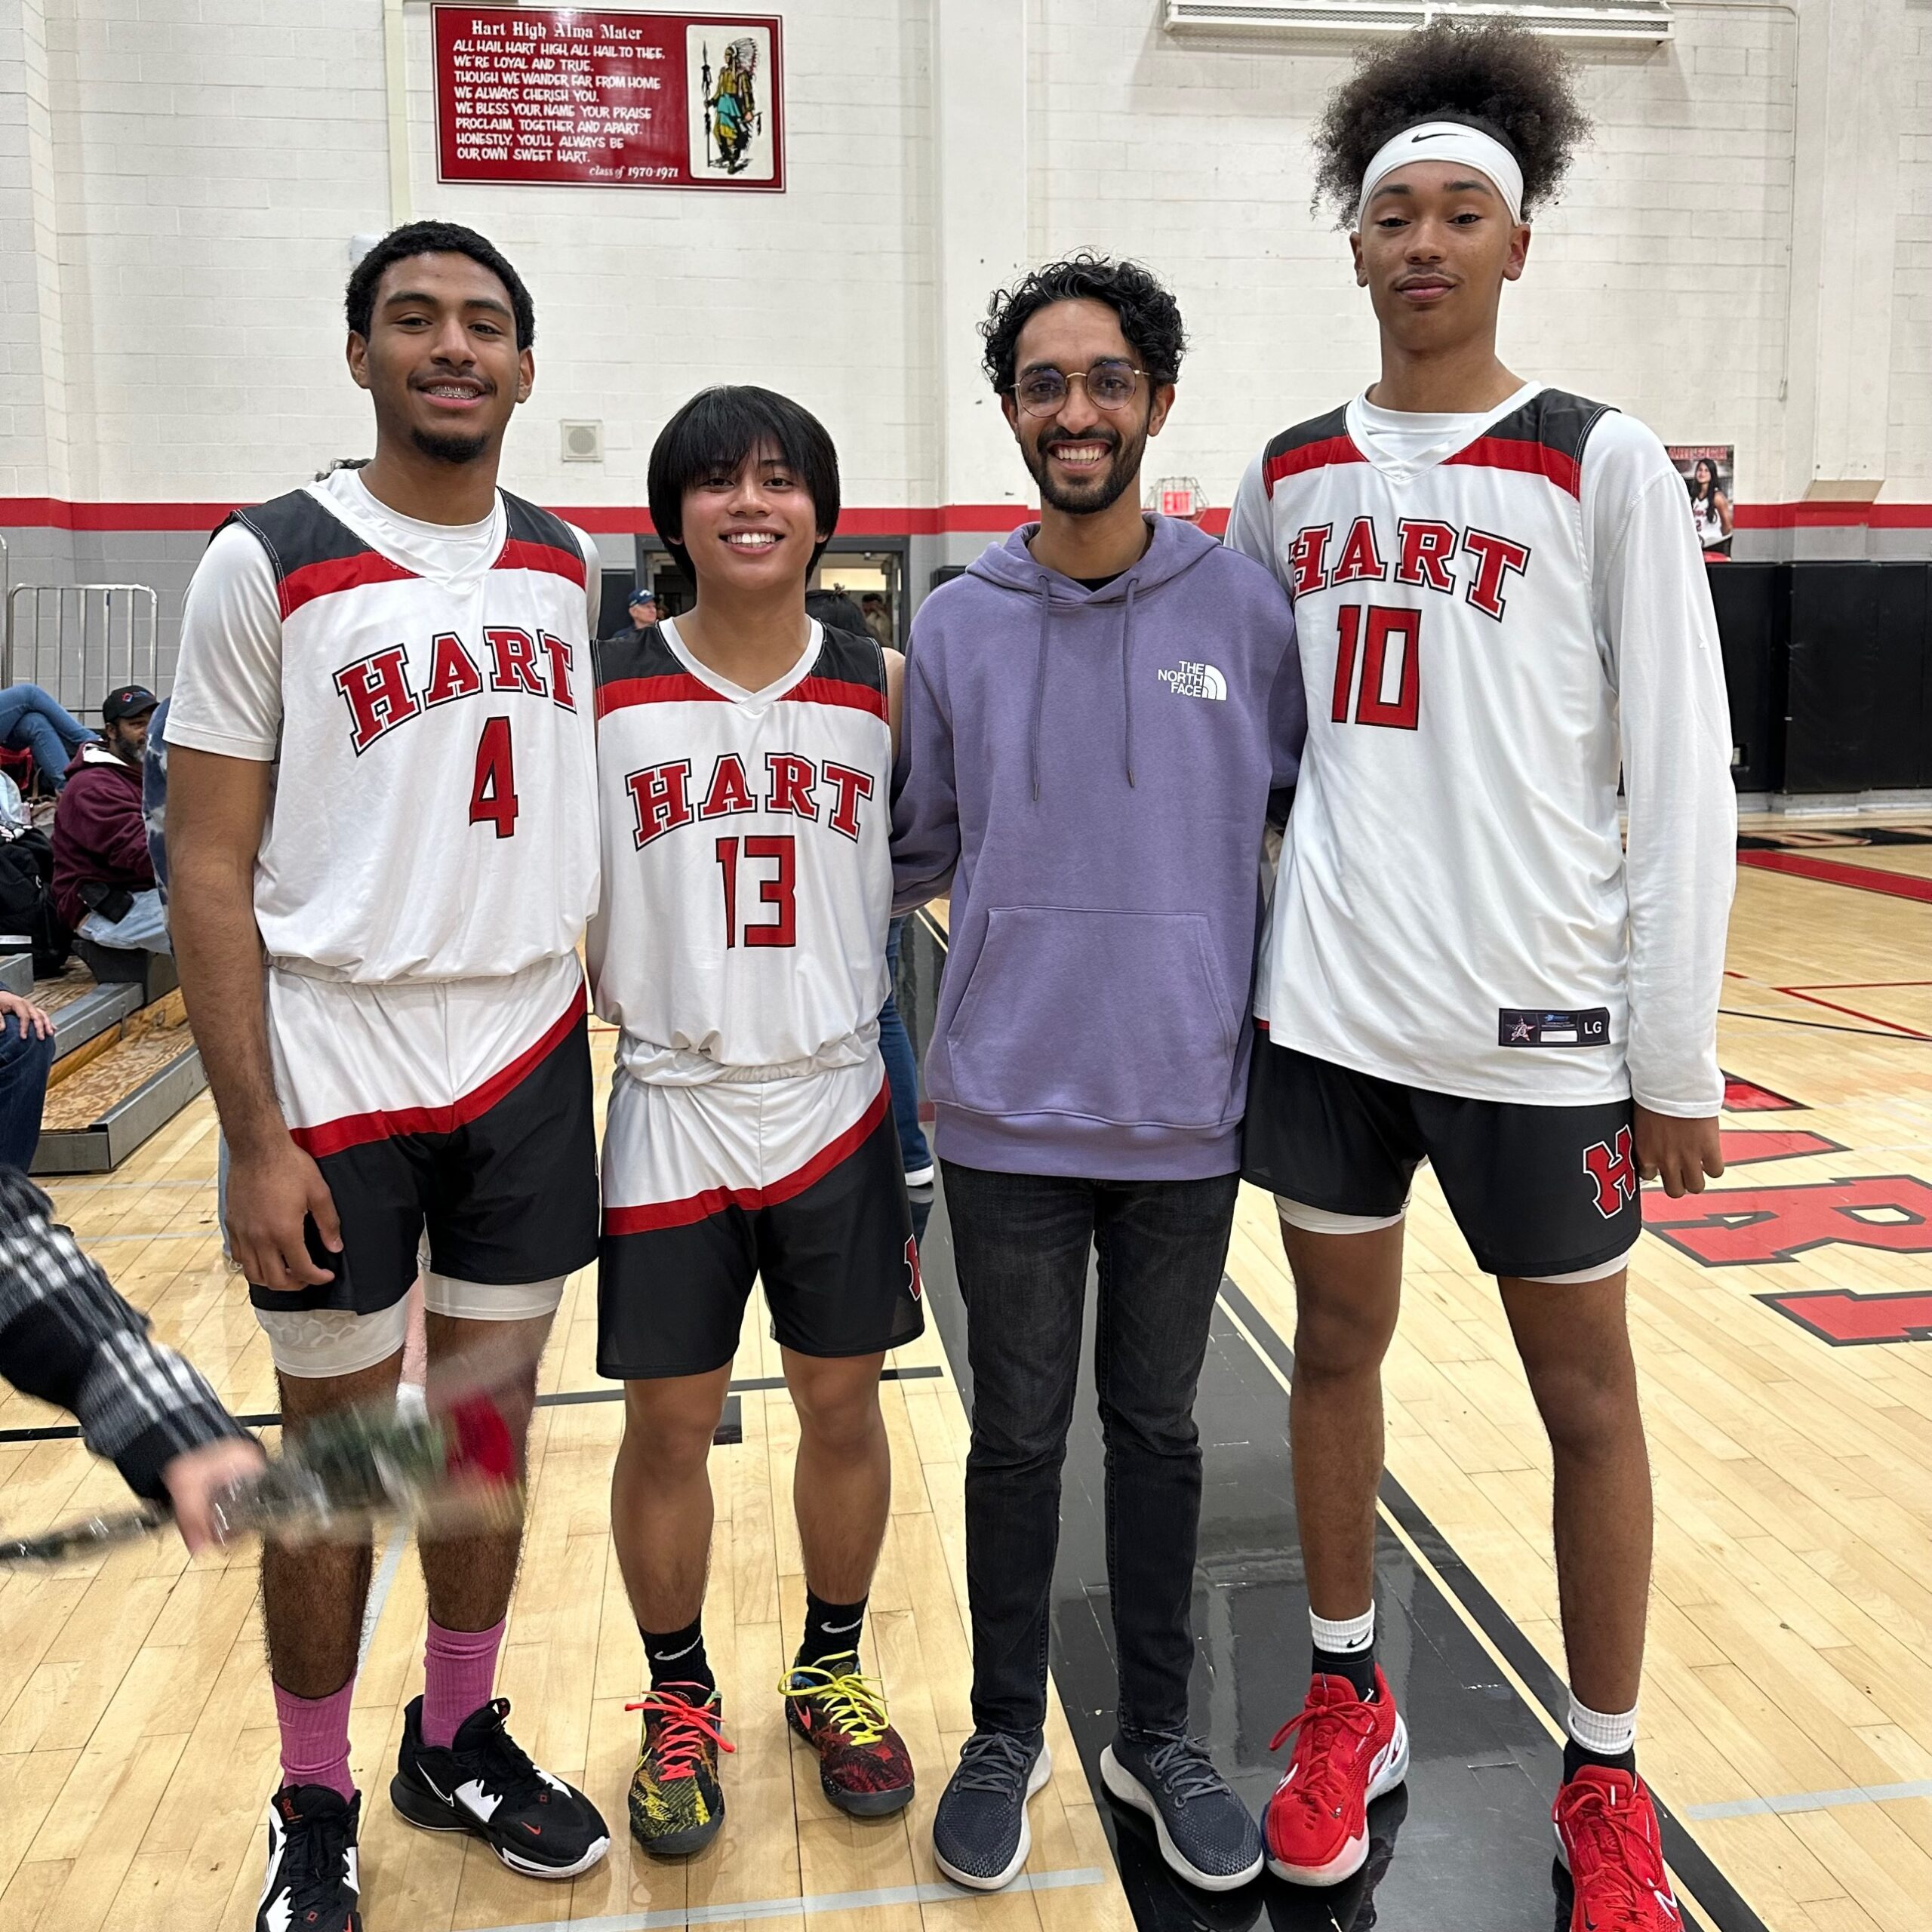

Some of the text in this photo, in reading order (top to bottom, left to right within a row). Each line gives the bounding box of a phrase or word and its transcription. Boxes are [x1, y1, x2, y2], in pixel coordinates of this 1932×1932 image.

[472, 20, 642, 40] Hart High Alma Mater
[454, 39, 474, 52] ALL
[476, 40, 503, 53] HAIL
[505, 42, 536, 55] HART
[571, 44, 591, 57] ALL
[593, 45, 618, 57] HAIL
[619, 46, 633, 58] TO
[635, 47, 665, 60] THEE.
[454, 54, 594, 72] WE'RE LOYAL AND TRUE.
[454, 70, 661, 90] THOUGH WE WANDER FAR FROM HOME
[454, 85, 599, 103] WE ALWAYS CHERISH YOU.
[455, 101, 652, 120] WE BLESS YOUR NAME YOUR PRAISE
[455, 117, 643, 136] PROCLAIM, TOGETHER AND APART.
[456, 132, 624, 149] HONESTLY, YOU'LL ALWAYS BE
[457, 146, 590, 164] OUR OWN SWEET HART.
[589, 165, 613, 176] class
[614, 166, 626, 179] of
[1288, 516, 1531, 623] HART
[1158, 669, 1203, 685] NORTH
[1178, 660, 1204, 675] THE
[1331, 605, 1422, 731] 10
[332, 626, 577, 758] HART
[1171, 682, 1201, 697] FACE
[469, 716, 518, 839] 4
[625, 752, 875, 851] HART
[715, 835, 796, 950] 13
[1584, 1021, 1602, 1035] LG
[1583, 1124, 1636, 1219] H
